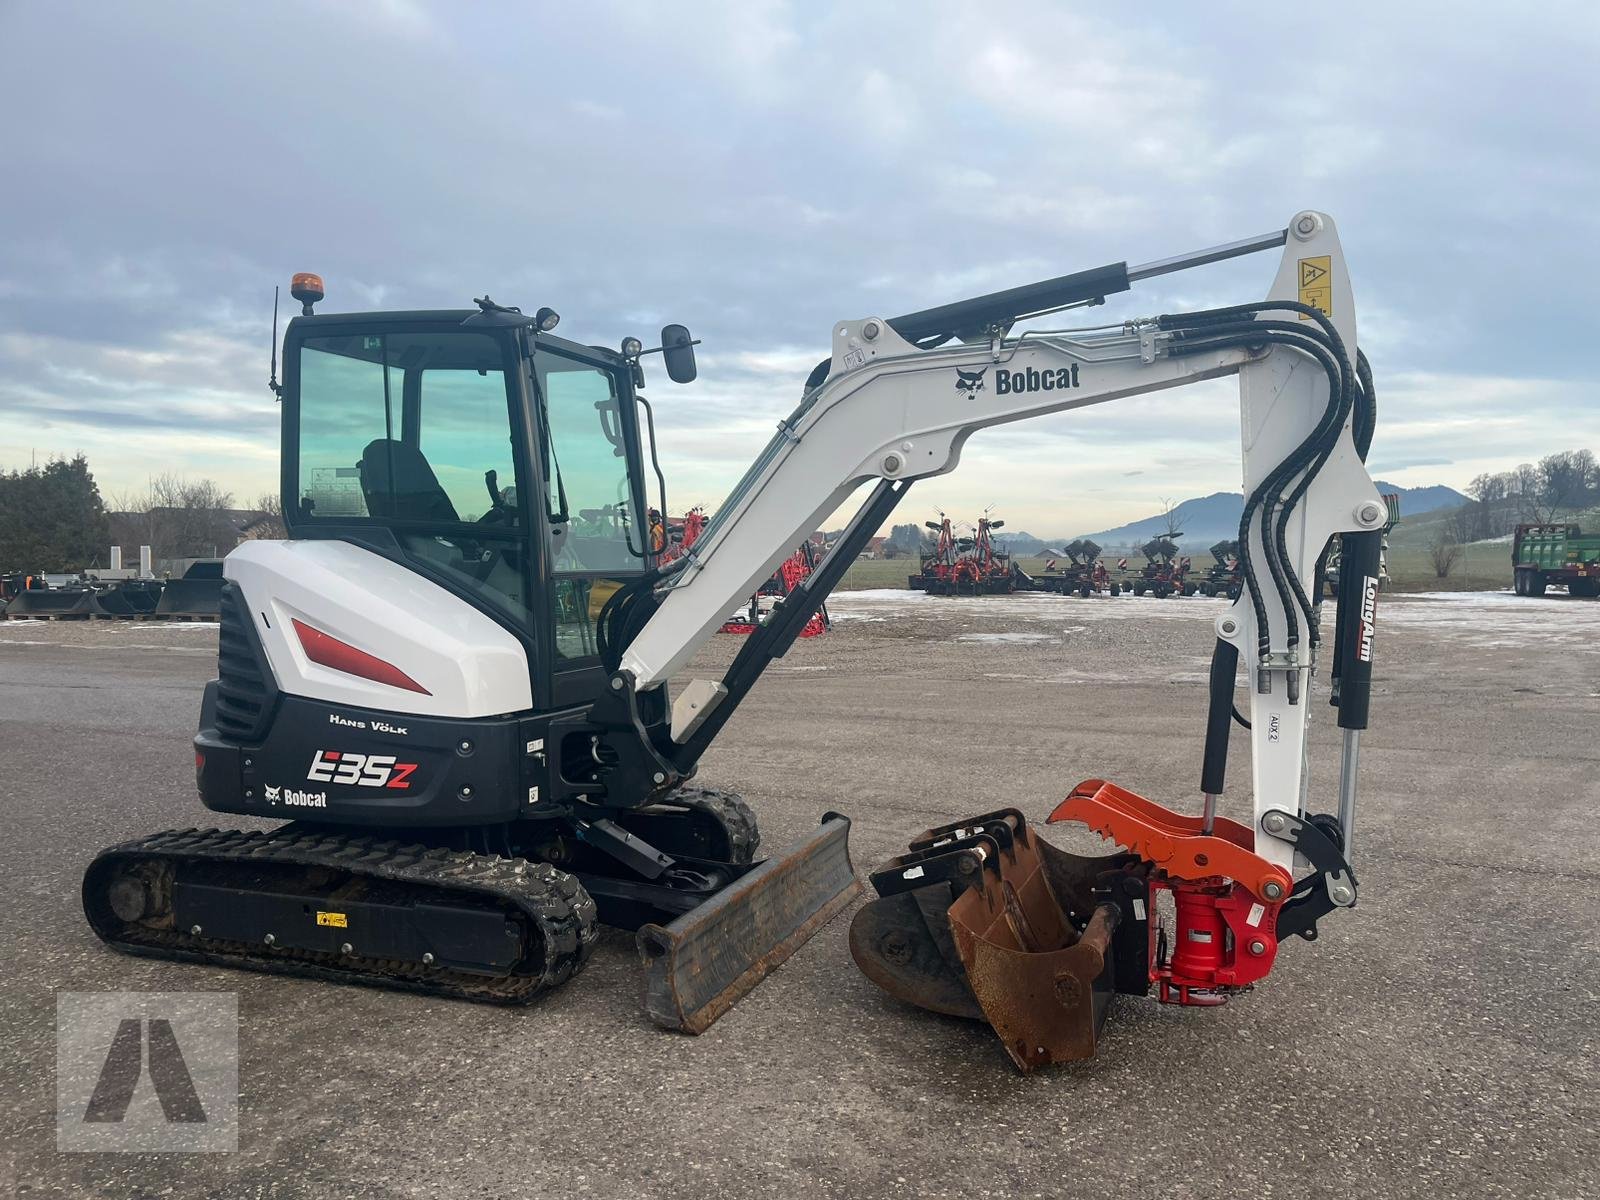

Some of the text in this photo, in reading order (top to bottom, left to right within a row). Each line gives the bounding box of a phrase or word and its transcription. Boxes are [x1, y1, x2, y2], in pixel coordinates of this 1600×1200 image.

[995, 363, 1080, 395] Bobcat
[1360, 576, 1378, 662] LongArm
[329, 714, 366, 729] HANS
[1270, 715, 1278, 733] AUX
[284, 789, 327, 808] Bobcat
